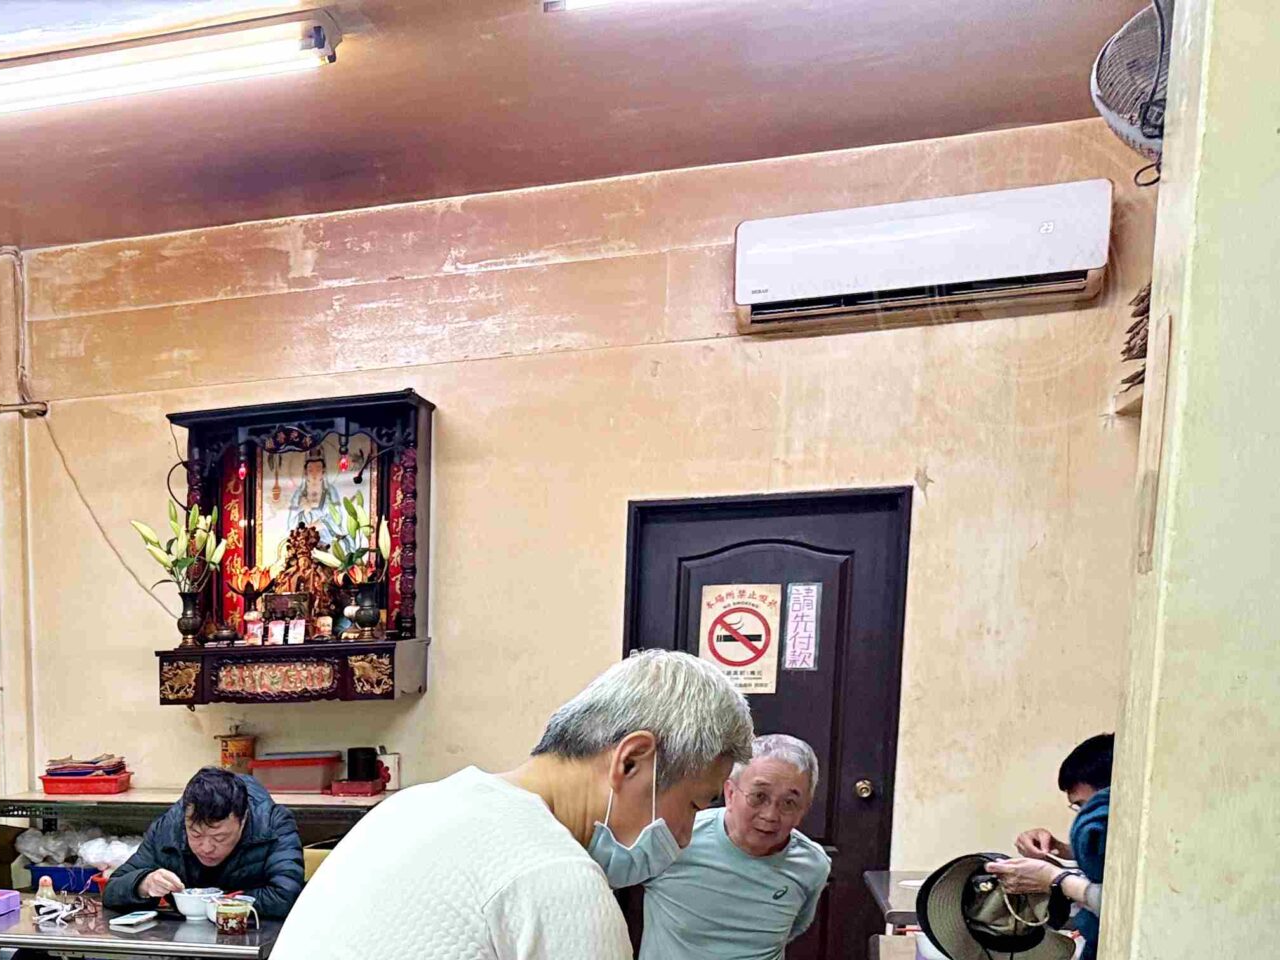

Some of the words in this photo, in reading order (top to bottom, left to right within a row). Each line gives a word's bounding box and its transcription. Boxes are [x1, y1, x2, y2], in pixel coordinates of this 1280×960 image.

[1039, 222, 1054, 234] 23
[788, 587, 815, 667] 請先付款
